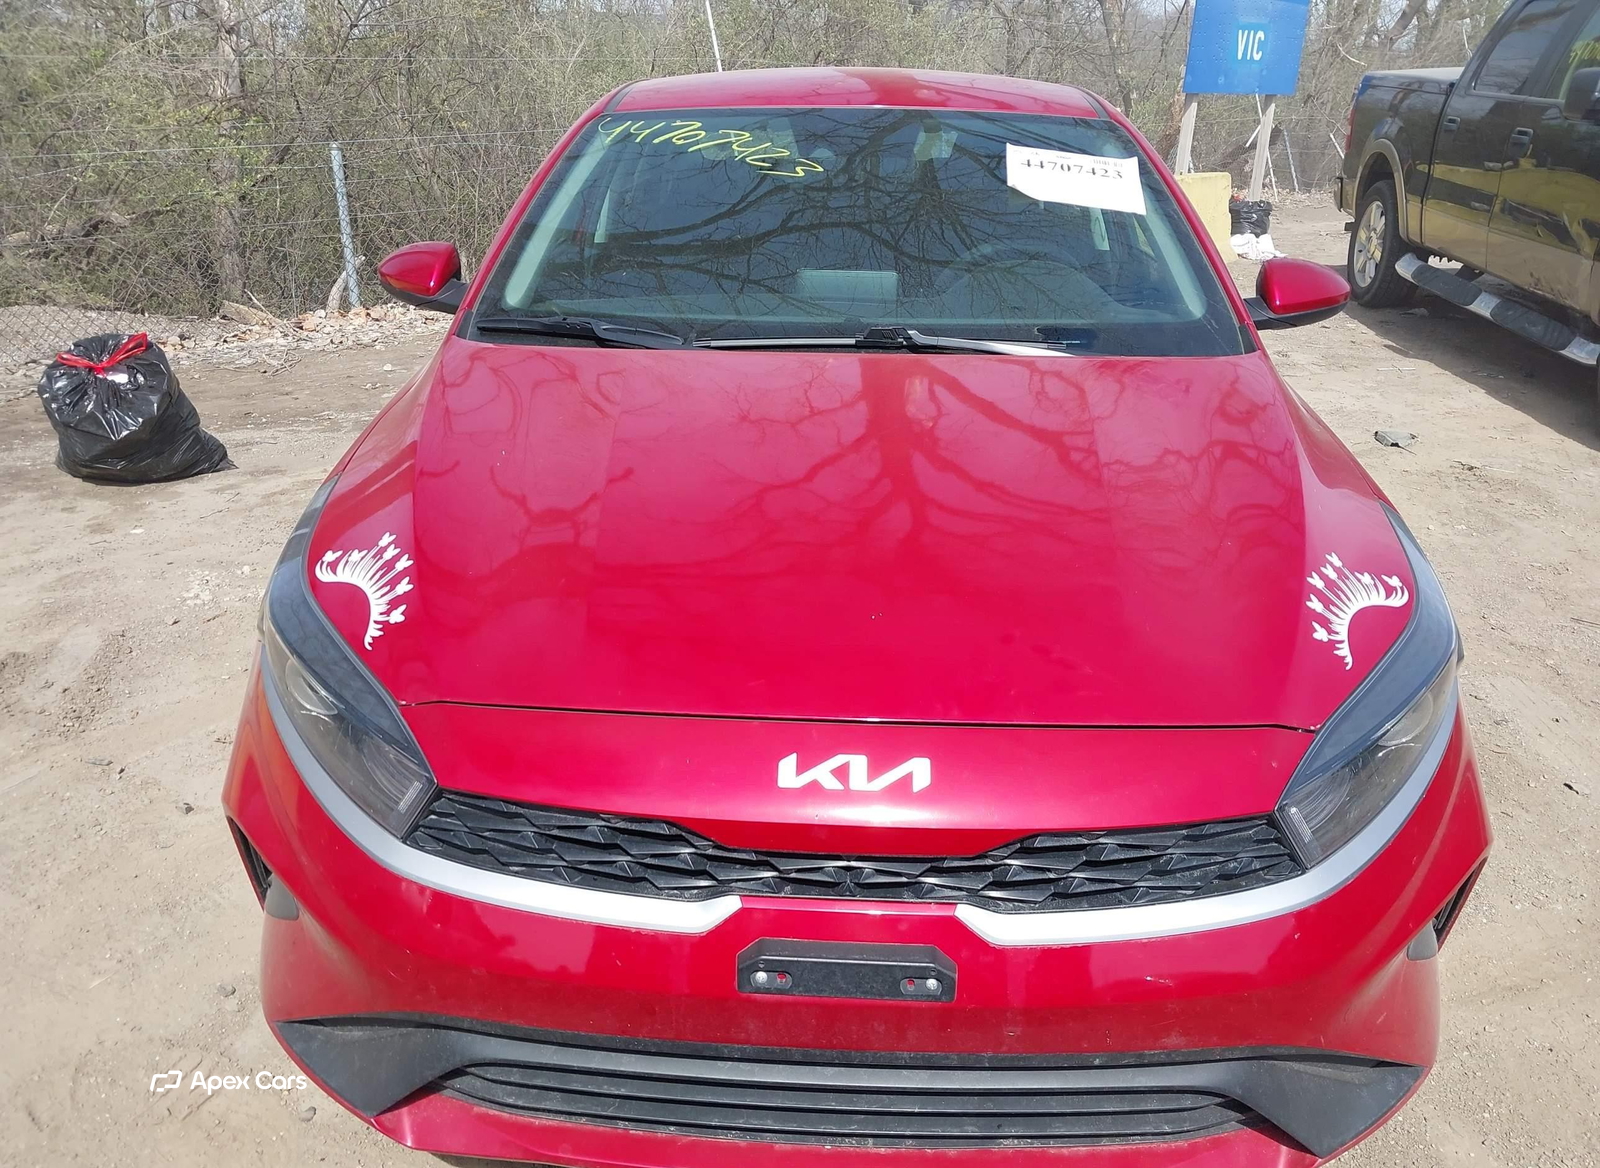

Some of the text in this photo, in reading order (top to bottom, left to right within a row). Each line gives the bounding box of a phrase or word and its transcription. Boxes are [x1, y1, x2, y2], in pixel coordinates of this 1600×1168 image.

[1237, 29, 1265, 61] VIC
[598, 117, 825, 177] 44707423
[1020, 158, 1123, 180] 44707423
[777, 752, 932, 794] KIA
